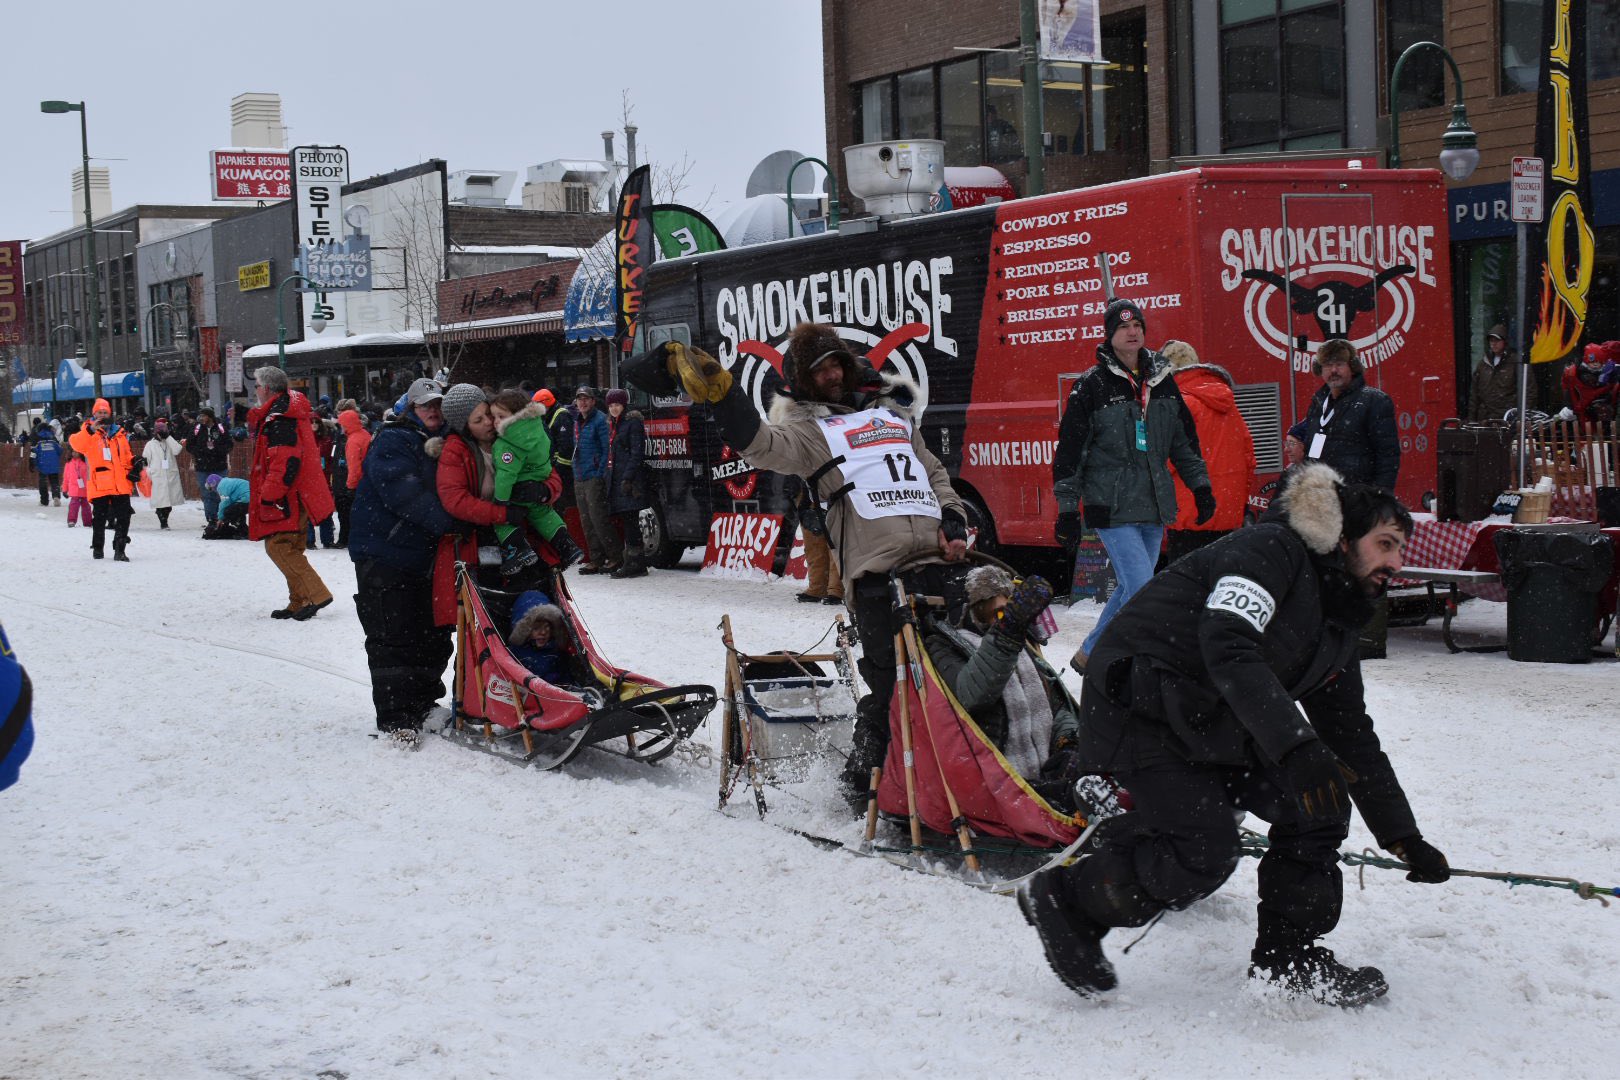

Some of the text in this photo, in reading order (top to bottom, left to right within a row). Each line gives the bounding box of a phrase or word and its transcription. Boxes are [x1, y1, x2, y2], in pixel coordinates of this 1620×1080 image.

[217, 156, 256, 166] JAPANESE
[300, 152, 343, 164] PHOTO
[300, 166, 343, 177] SHOP
[1514, 182, 1541, 191] PASSENGER
[1517, 194, 1537, 203] LOADING
[1002, 201, 1128, 234] COWBOY FRIES
[1521, 206, 1534, 215] ZONE
[1002, 231, 1091, 256] ESPRESSO
[618, 193, 644, 338] TURKEY
[1004, 256, 1090, 280] REINDEER
[1220, 225, 1437, 292] SMOKEHOUSE
[308, 264, 368, 278] PHOTO
[316, 279, 359, 288] SHOP
[1006, 284, 1050, 301] PORK
[717, 255, 959, 371] SMOKEHOUSE
[1007, 293, 1182, 324] BRISKET SAWICH
[1008, 325, 1105, 346] TURKEY LE
[1359, 331, 1405, 369] ATERING
[711, 459, 754, 480] MEA
[883, 452, 918, 483] 12
[867, 489, 924, 502] IDITAROD
[710, 514, 781, 556] TURKEY
[717, 547, 755, 571] LEGS
[1220, 590, 1269, 627] 2020
